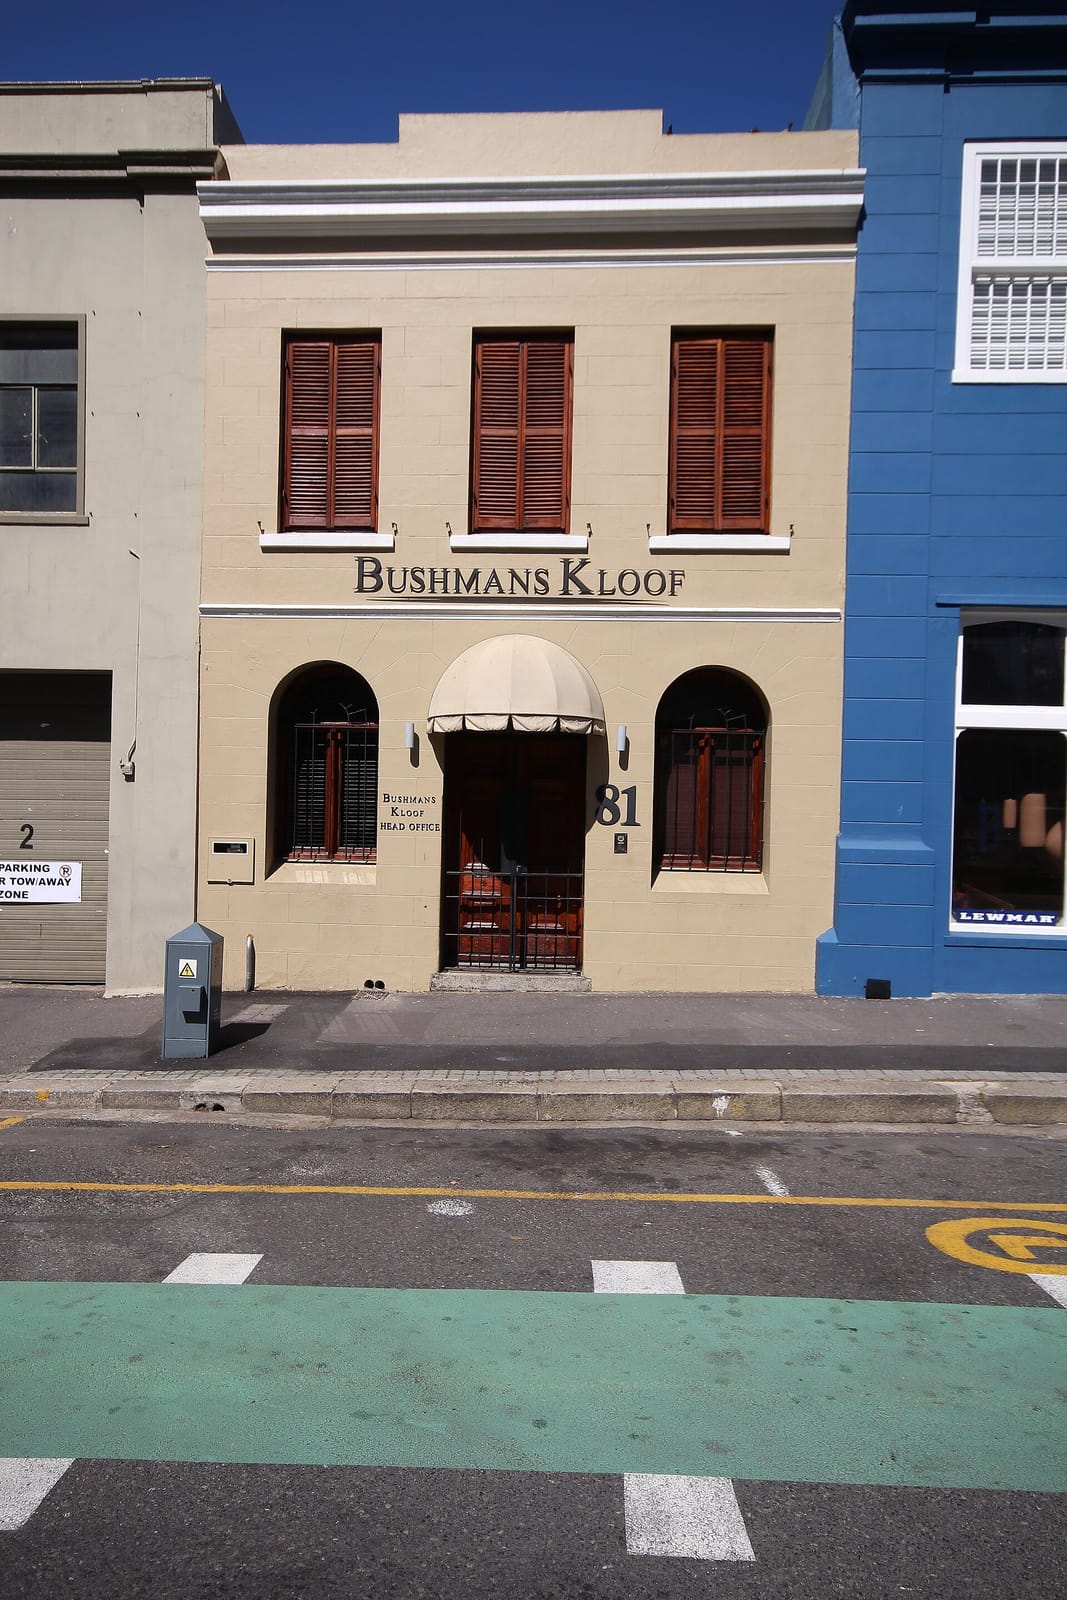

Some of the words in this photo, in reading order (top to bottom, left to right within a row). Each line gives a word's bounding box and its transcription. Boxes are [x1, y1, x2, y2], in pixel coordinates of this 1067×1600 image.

[354, 555, 550, 595] BUSHMANS
[558, 556, 686, 597] KLOOF
[383, 793, 436, 804] BUSHMANS
[595, 784, 641, 826] 81
[390, 806, 425, 817] KLOOF
[380, 822, 406, 831] HEAD
[408, 823, 441, 832] OFFICE
[19, 823, 34, 850] 2
[0, 863, 51, 873] PARKING
[9, 877, 72, 887] TOW/AWAY
[0, 890, 30, 899] ZONE
[959, 912, 1055, 923] LEWMAR
